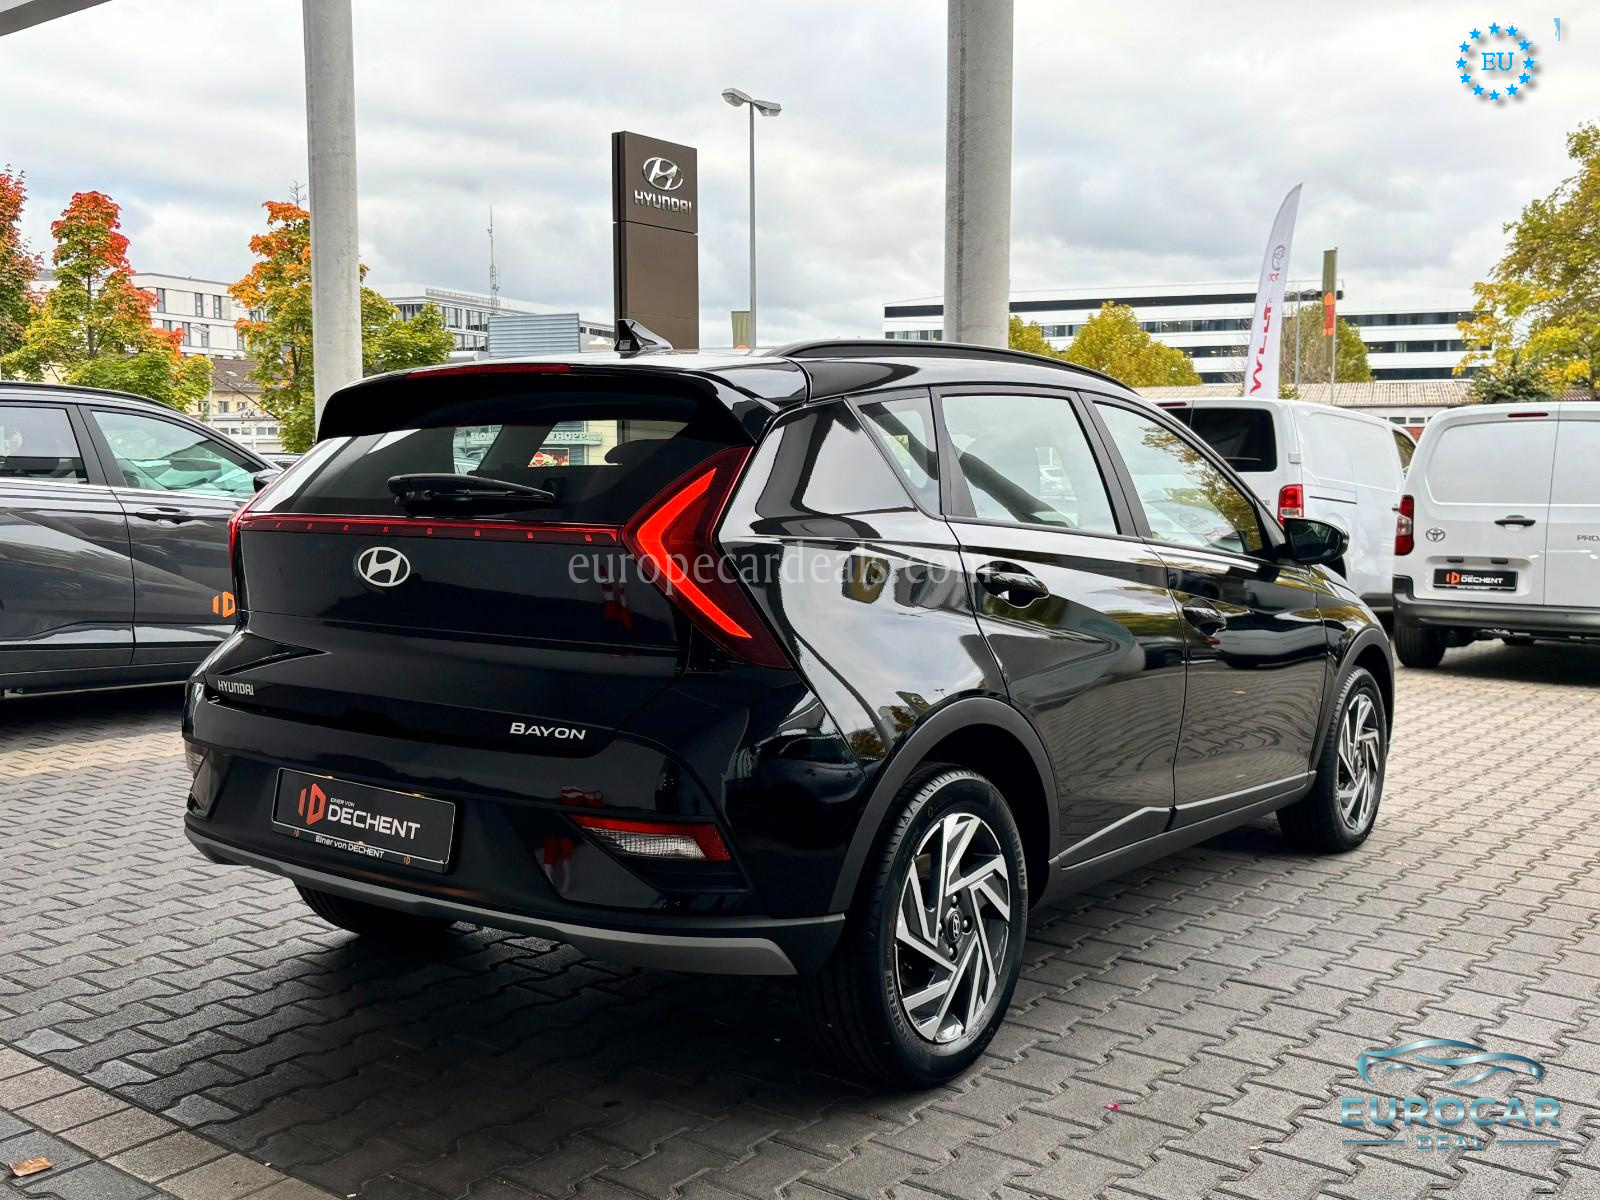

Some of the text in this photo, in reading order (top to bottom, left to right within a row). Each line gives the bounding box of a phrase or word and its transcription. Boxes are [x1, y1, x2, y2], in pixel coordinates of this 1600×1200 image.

[634, 189, 692, 215] HYUNDAI
[1576, 534, 1600, 542] PRO
[1461, 575, 1504, 585] DECHENT
[217, 680, 254, 696] HYUNDAI
[510, 722, 586, 740] BAYON
[344, 800, 355, 808] VON
[328, 804, 420, 840] DECHENT
[315, 835, 385, 859] Einer von DECHENT
[1005, 818, 1025, 886] ICHELIN
